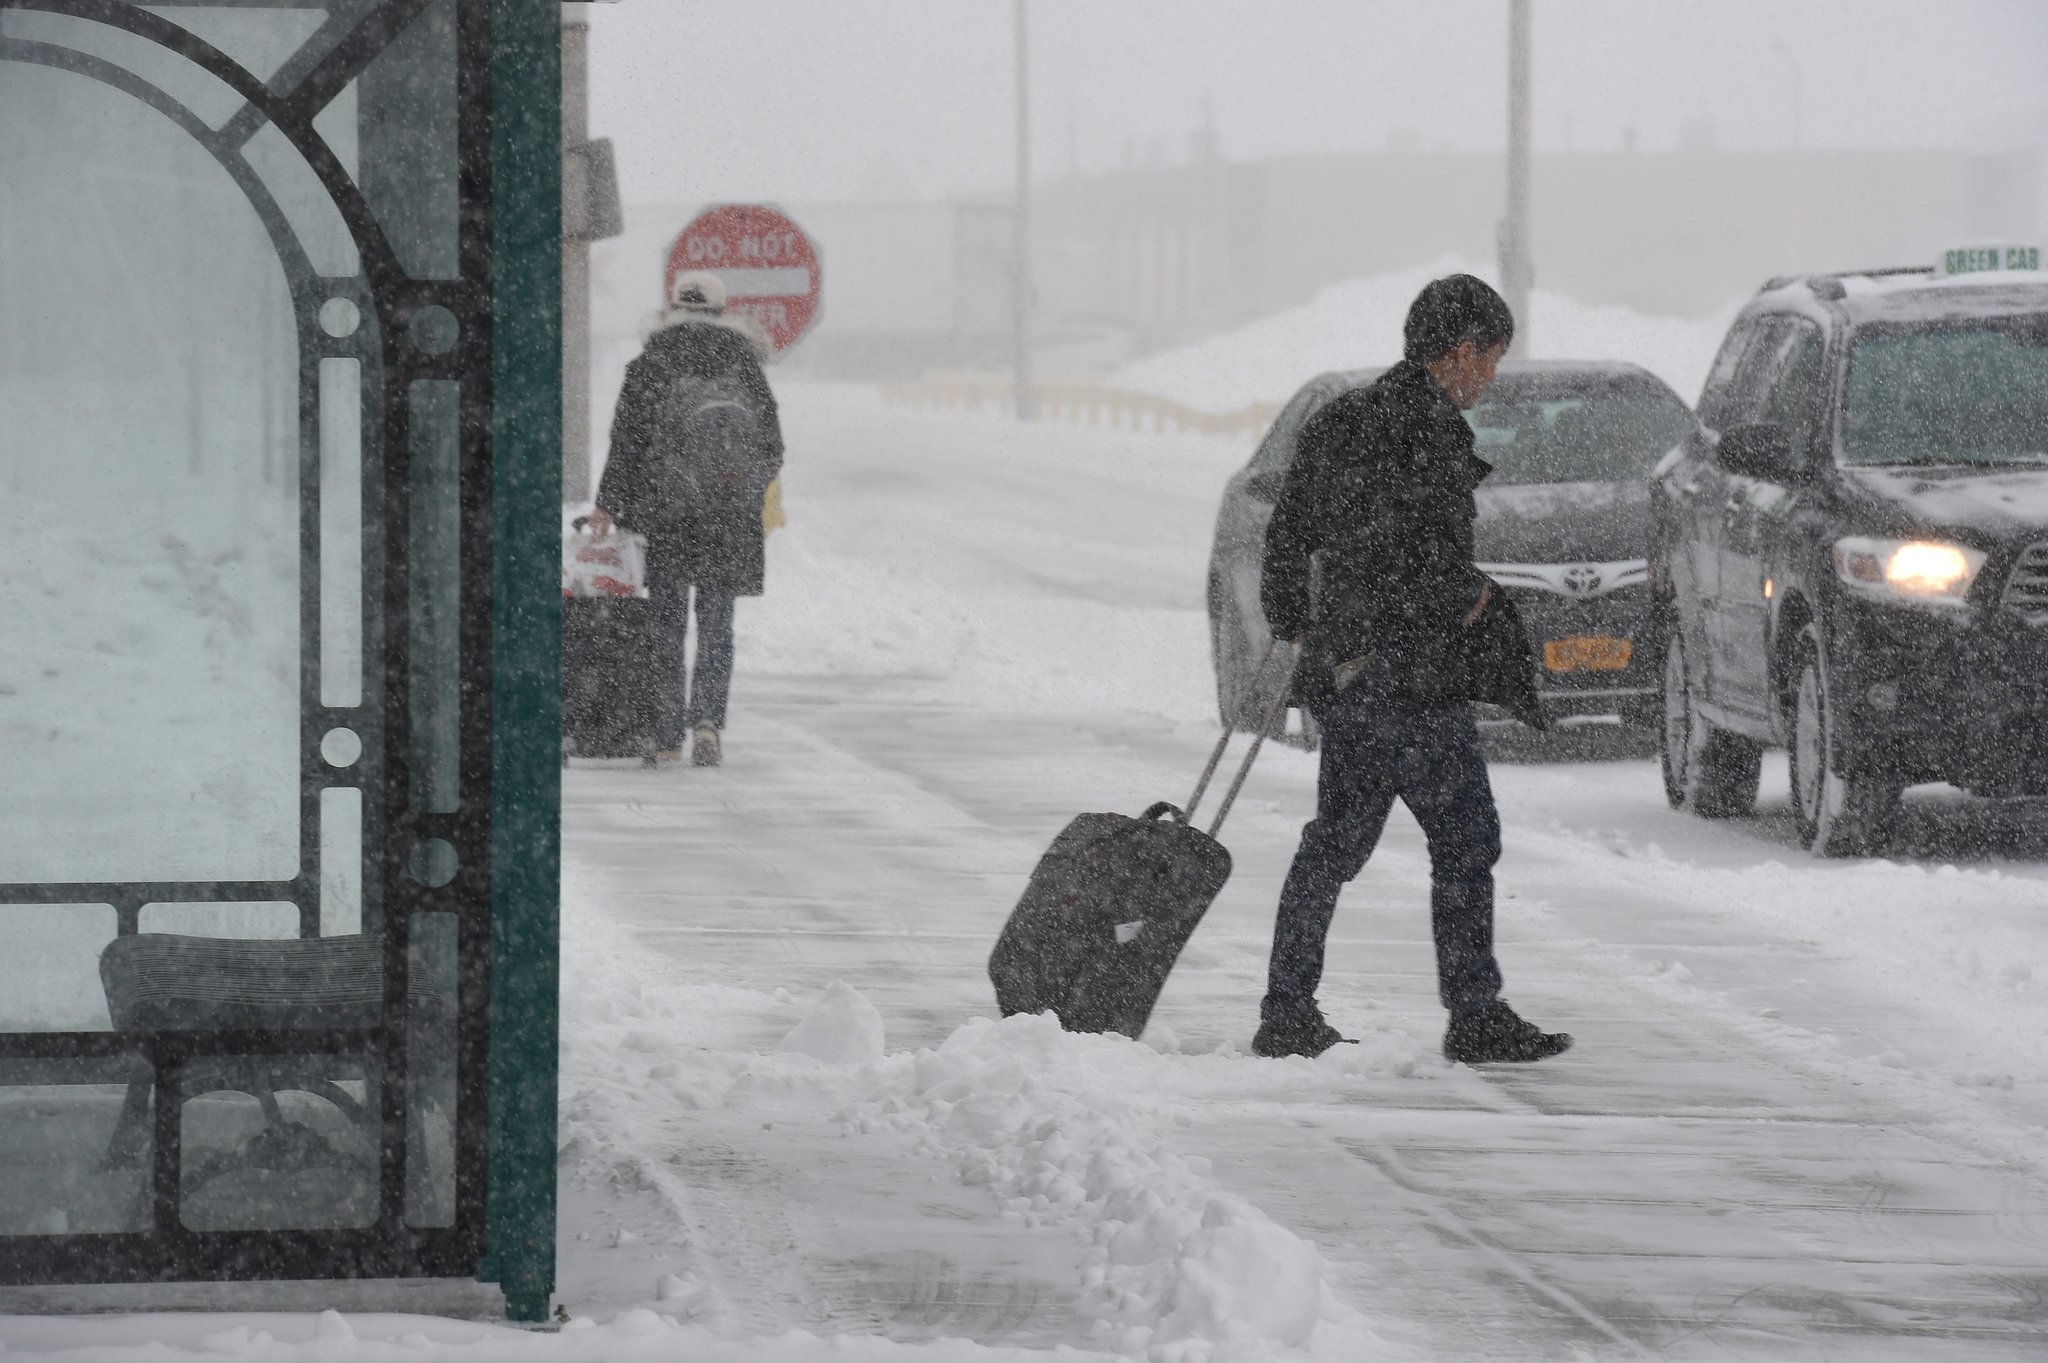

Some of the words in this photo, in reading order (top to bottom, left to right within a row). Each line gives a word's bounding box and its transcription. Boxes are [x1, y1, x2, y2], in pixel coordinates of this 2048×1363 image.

[687, 236, 725, 261] DO
[741, 232, 798, 259] NOT
[1945, 248, 1998, 274] GREEN
[2006, 247, 2038, 271] CAB
